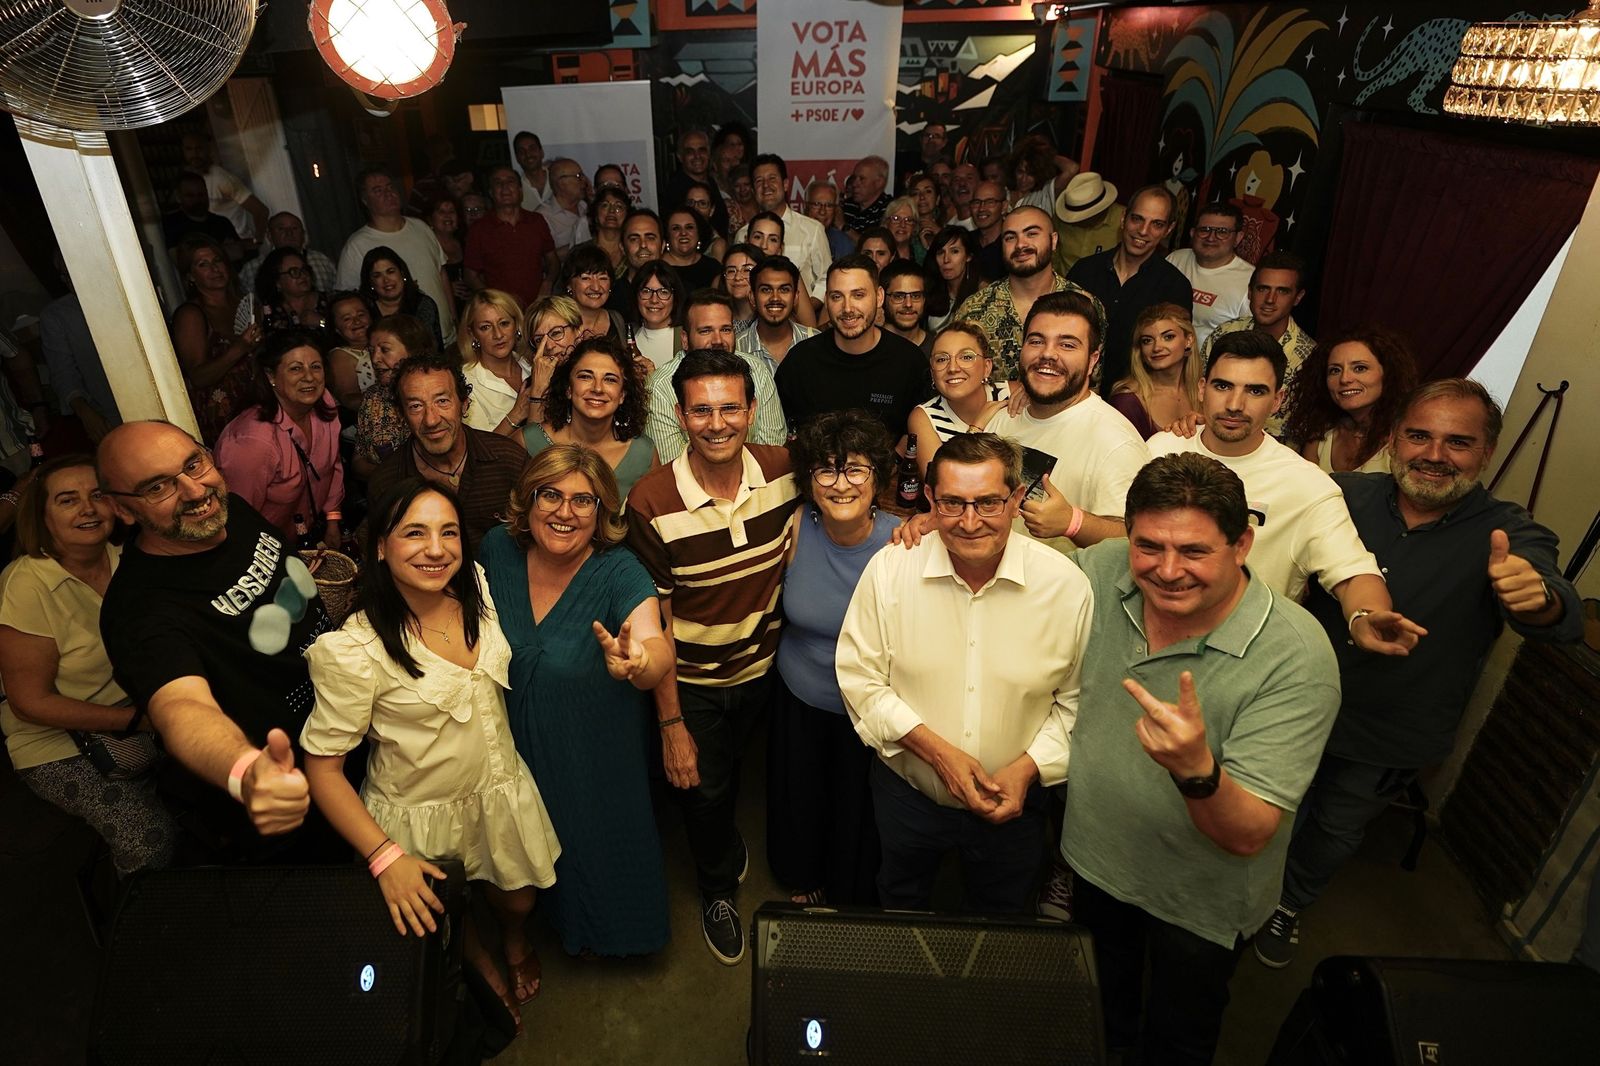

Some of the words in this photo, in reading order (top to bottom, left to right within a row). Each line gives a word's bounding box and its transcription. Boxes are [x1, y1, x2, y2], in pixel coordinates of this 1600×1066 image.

[791, 20, 867, 44] VOTA
[791, 43, 867, 79] MÁS
[791, 79, 865, 96] EUROPA
